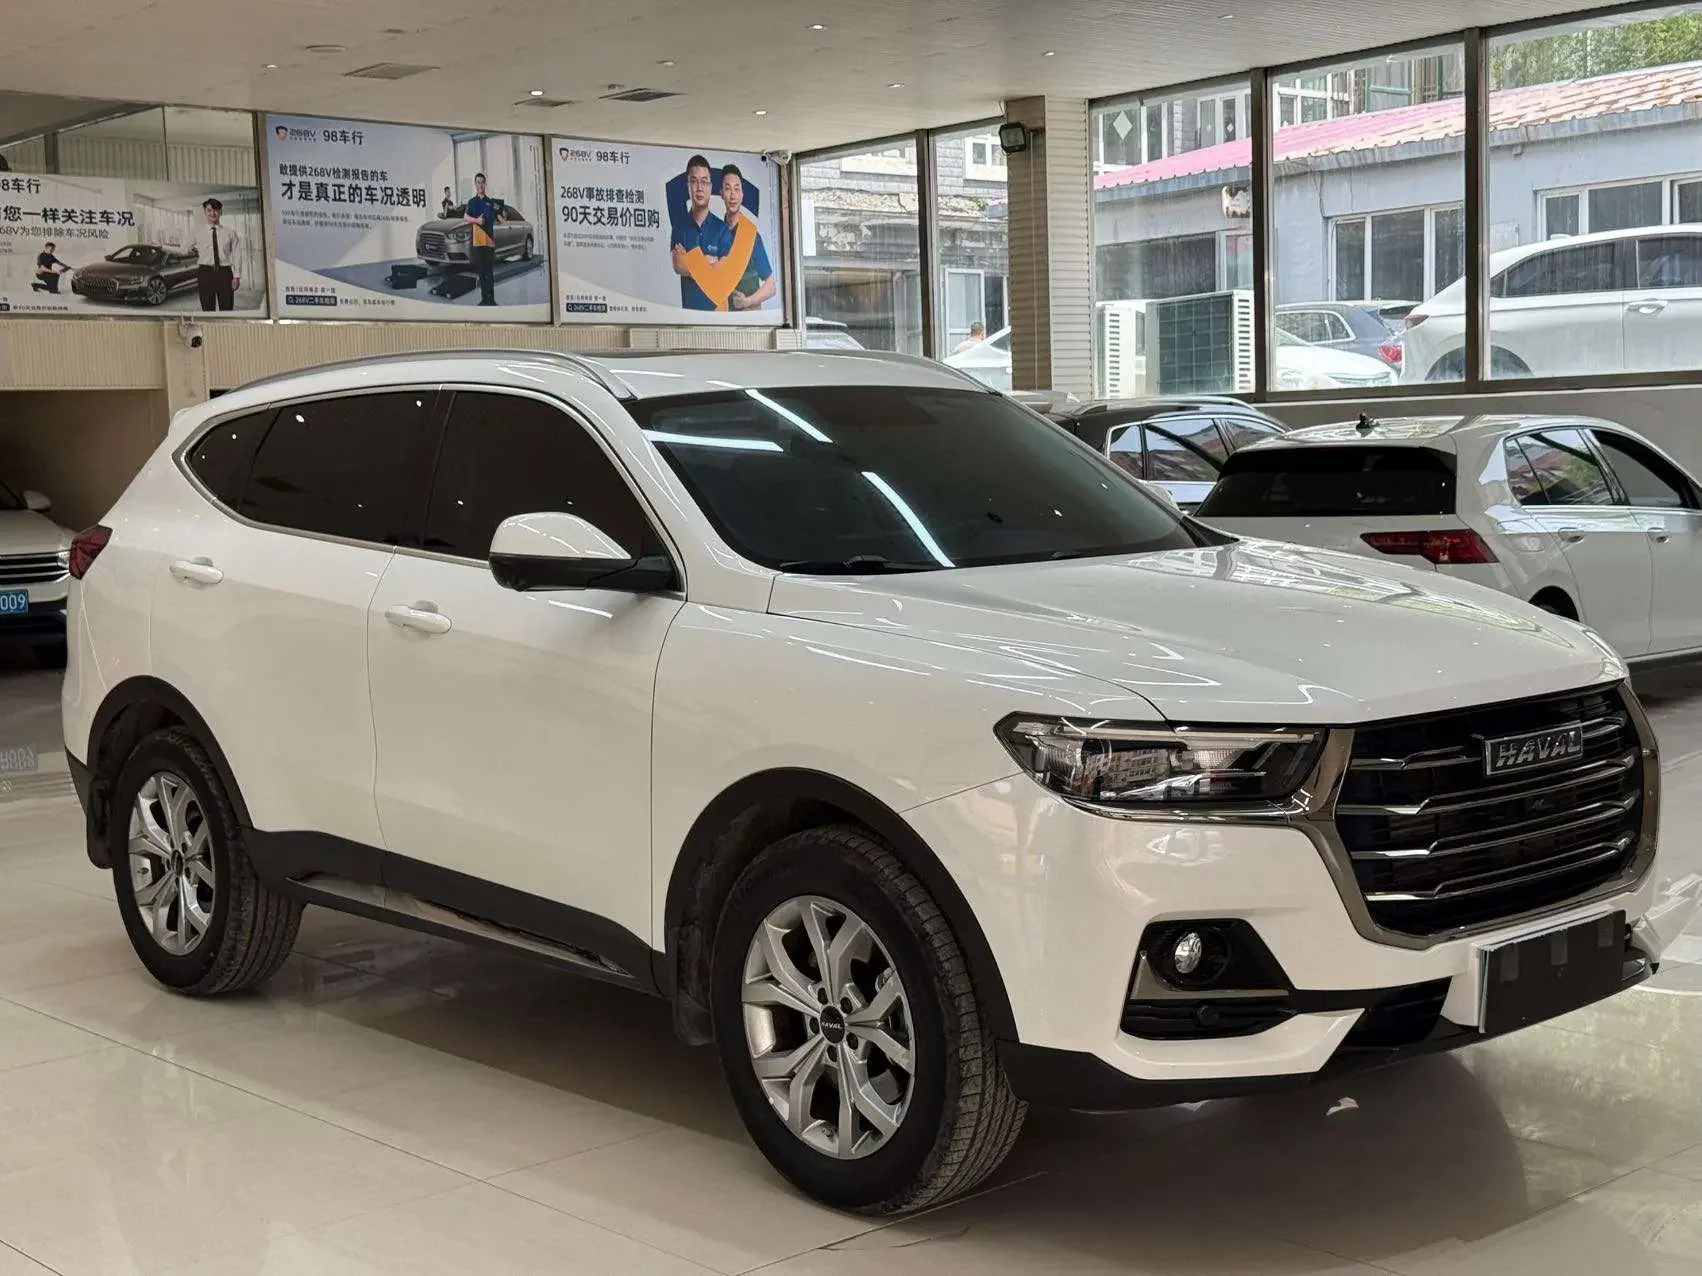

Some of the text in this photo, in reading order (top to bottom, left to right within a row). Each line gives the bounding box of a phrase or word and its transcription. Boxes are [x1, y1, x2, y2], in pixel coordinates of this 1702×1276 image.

[323, 129, 364, 145] 98车行
[596, 150, 630, 164] 98车行
[279, 163, 389, 182] 敢提供268V检测报告的车
[0, 177, 41, 194] 8车行
[281, 179, 426, 208] 才是真正的车况透明
[560, 186, 645, 204] 268V事故排查检测
[0, 205, 136, 227] 您一样关注车况
[562, 205, 660, 229] 90天交易价回购
[0, 593, 26, 611] 009
[1495, 730, 1581, 767] HAVAL
